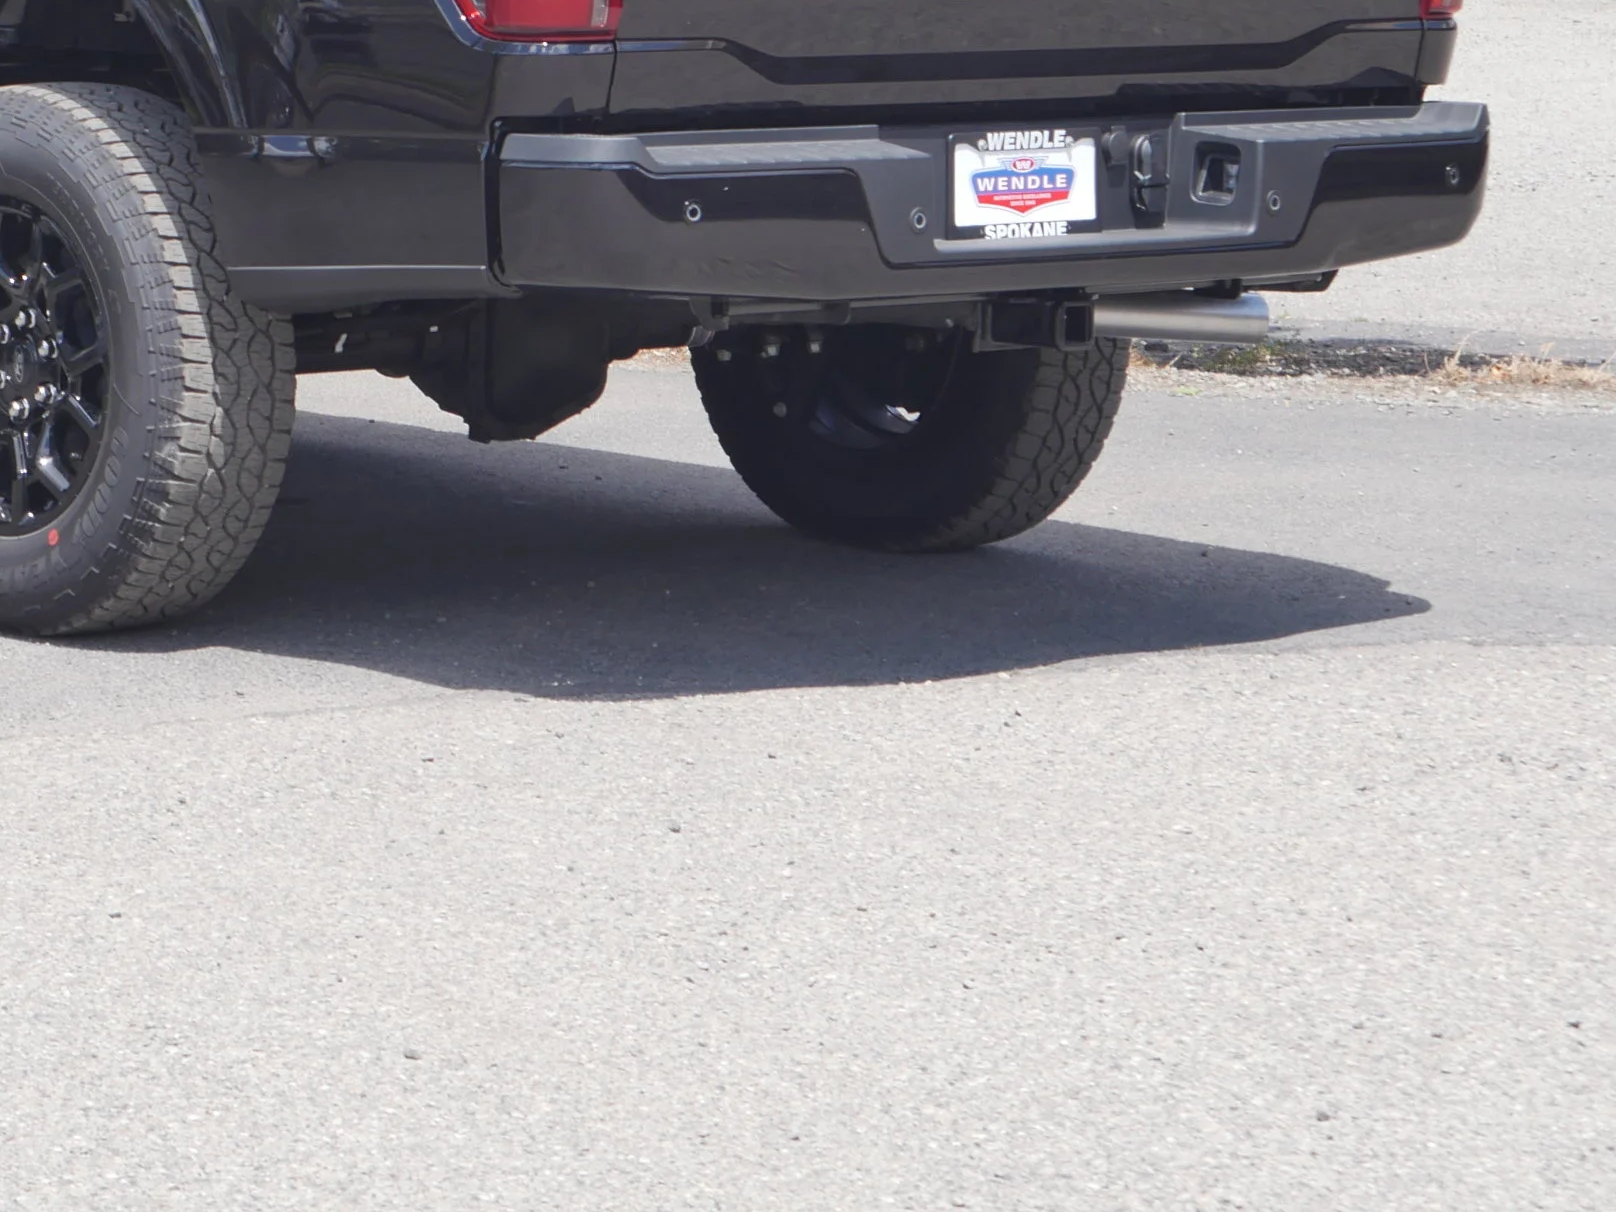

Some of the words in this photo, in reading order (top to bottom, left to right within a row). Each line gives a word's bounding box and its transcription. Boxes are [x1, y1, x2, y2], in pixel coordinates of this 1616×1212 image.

[986, 129, 1067, 151] WENDLE
[976, 174, 1068, 192] WENDLE
[984, 221, 1069, 240] SPOKANE
